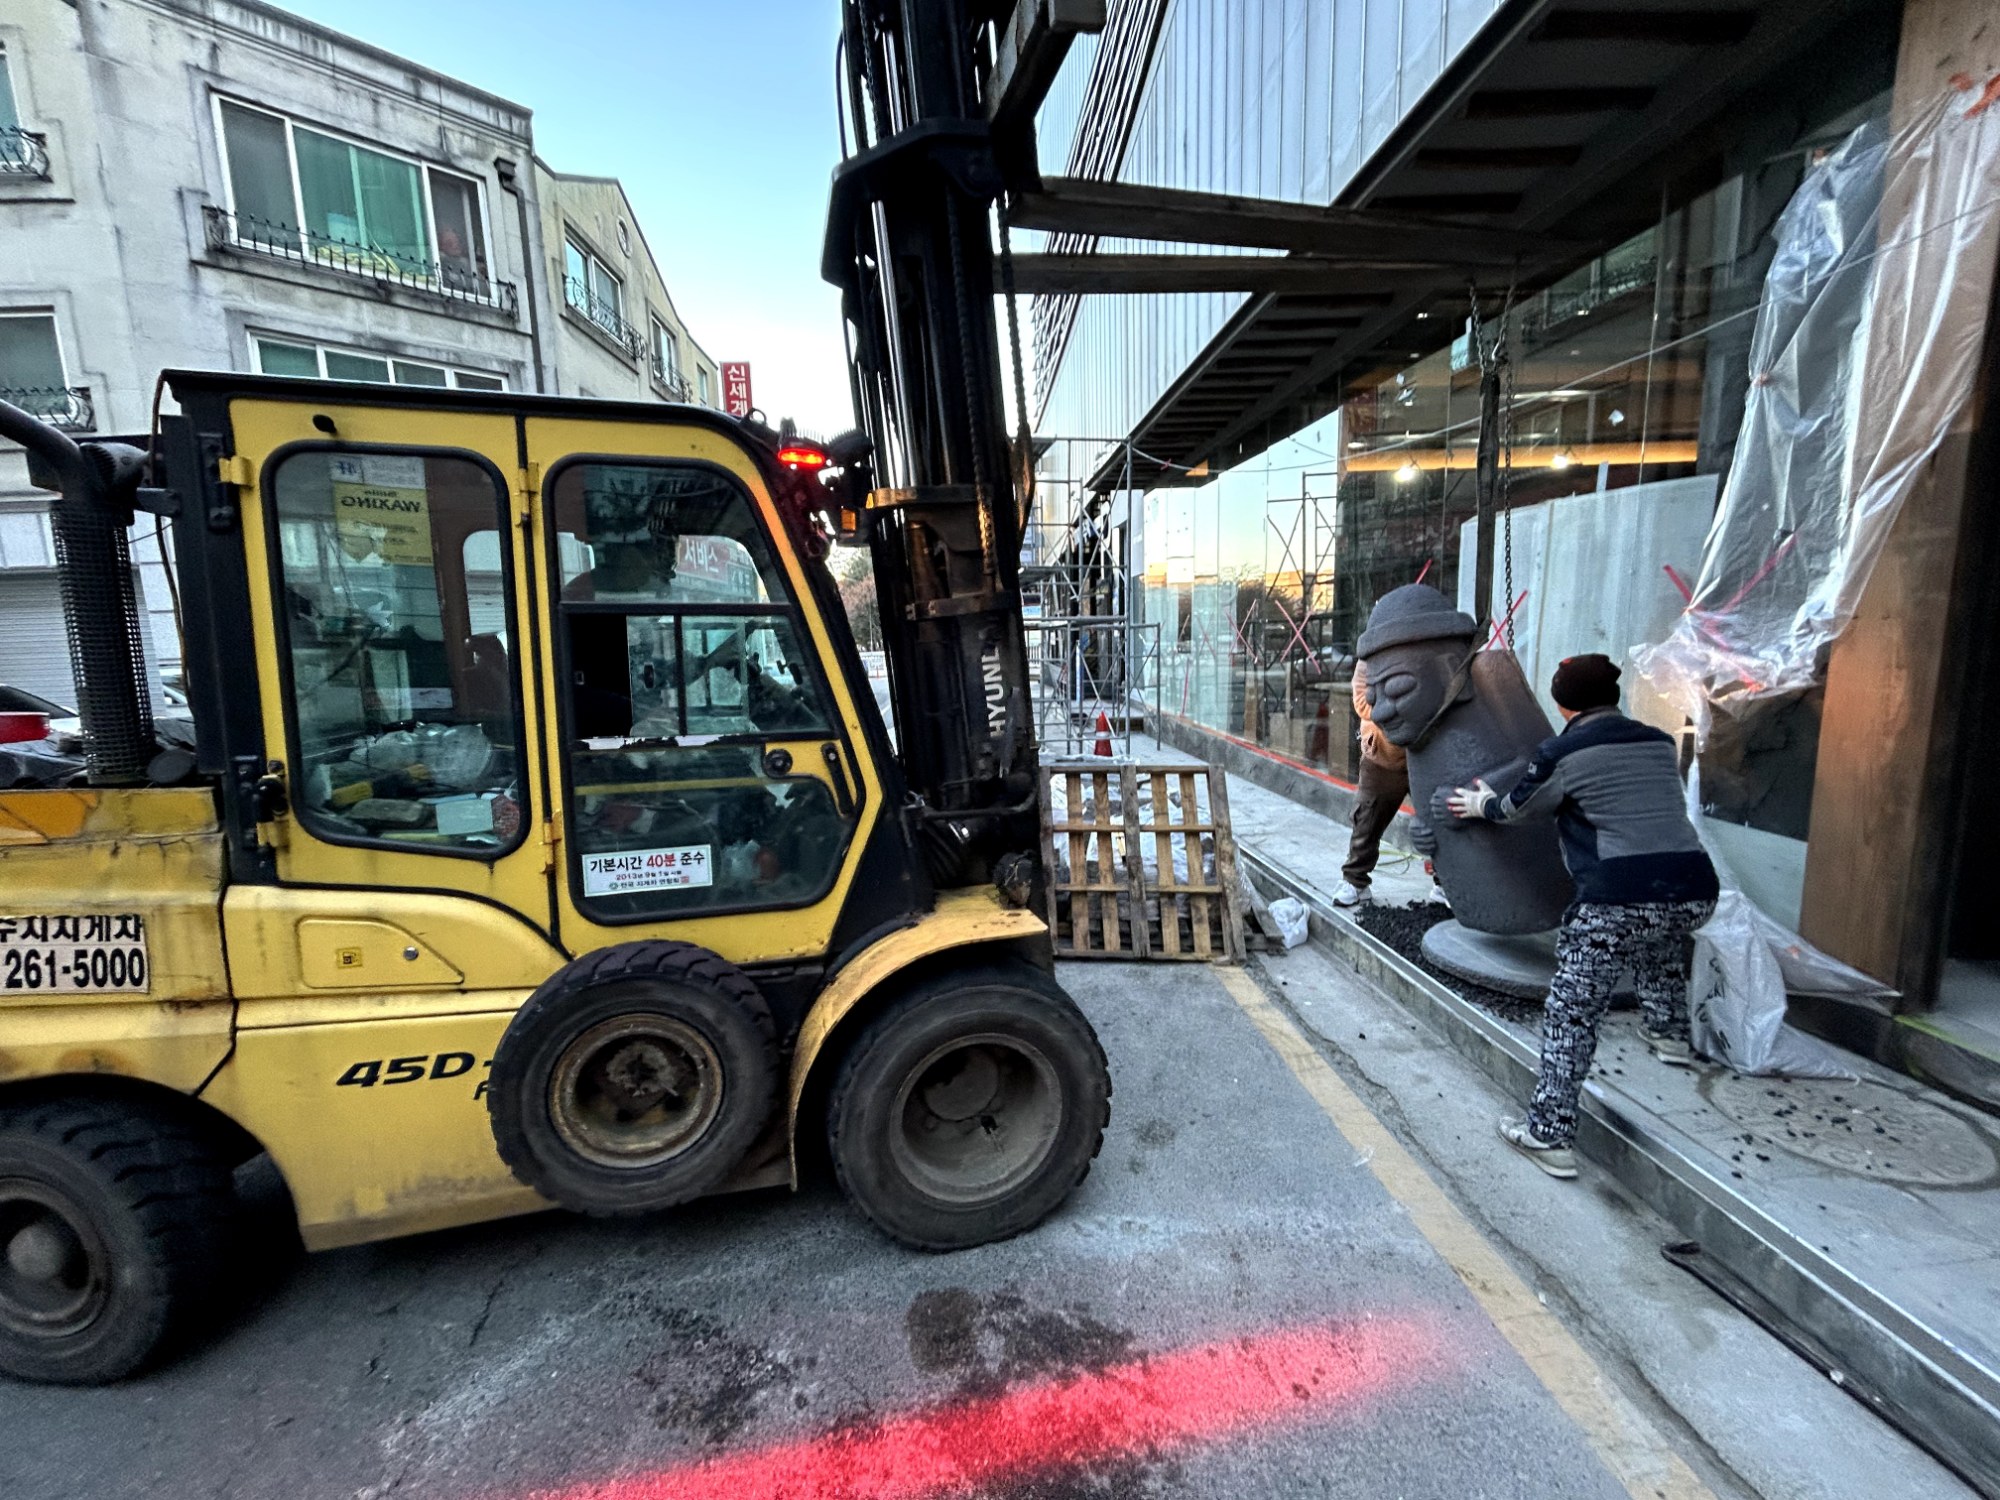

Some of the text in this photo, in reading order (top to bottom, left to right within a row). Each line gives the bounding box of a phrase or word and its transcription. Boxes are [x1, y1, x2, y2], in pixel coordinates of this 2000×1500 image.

[684, 538, 719, 573] 서비스
[590, 851, 705, 873] 기본시간 40분 준수
[5, 947, 145, 989] 261-5000
